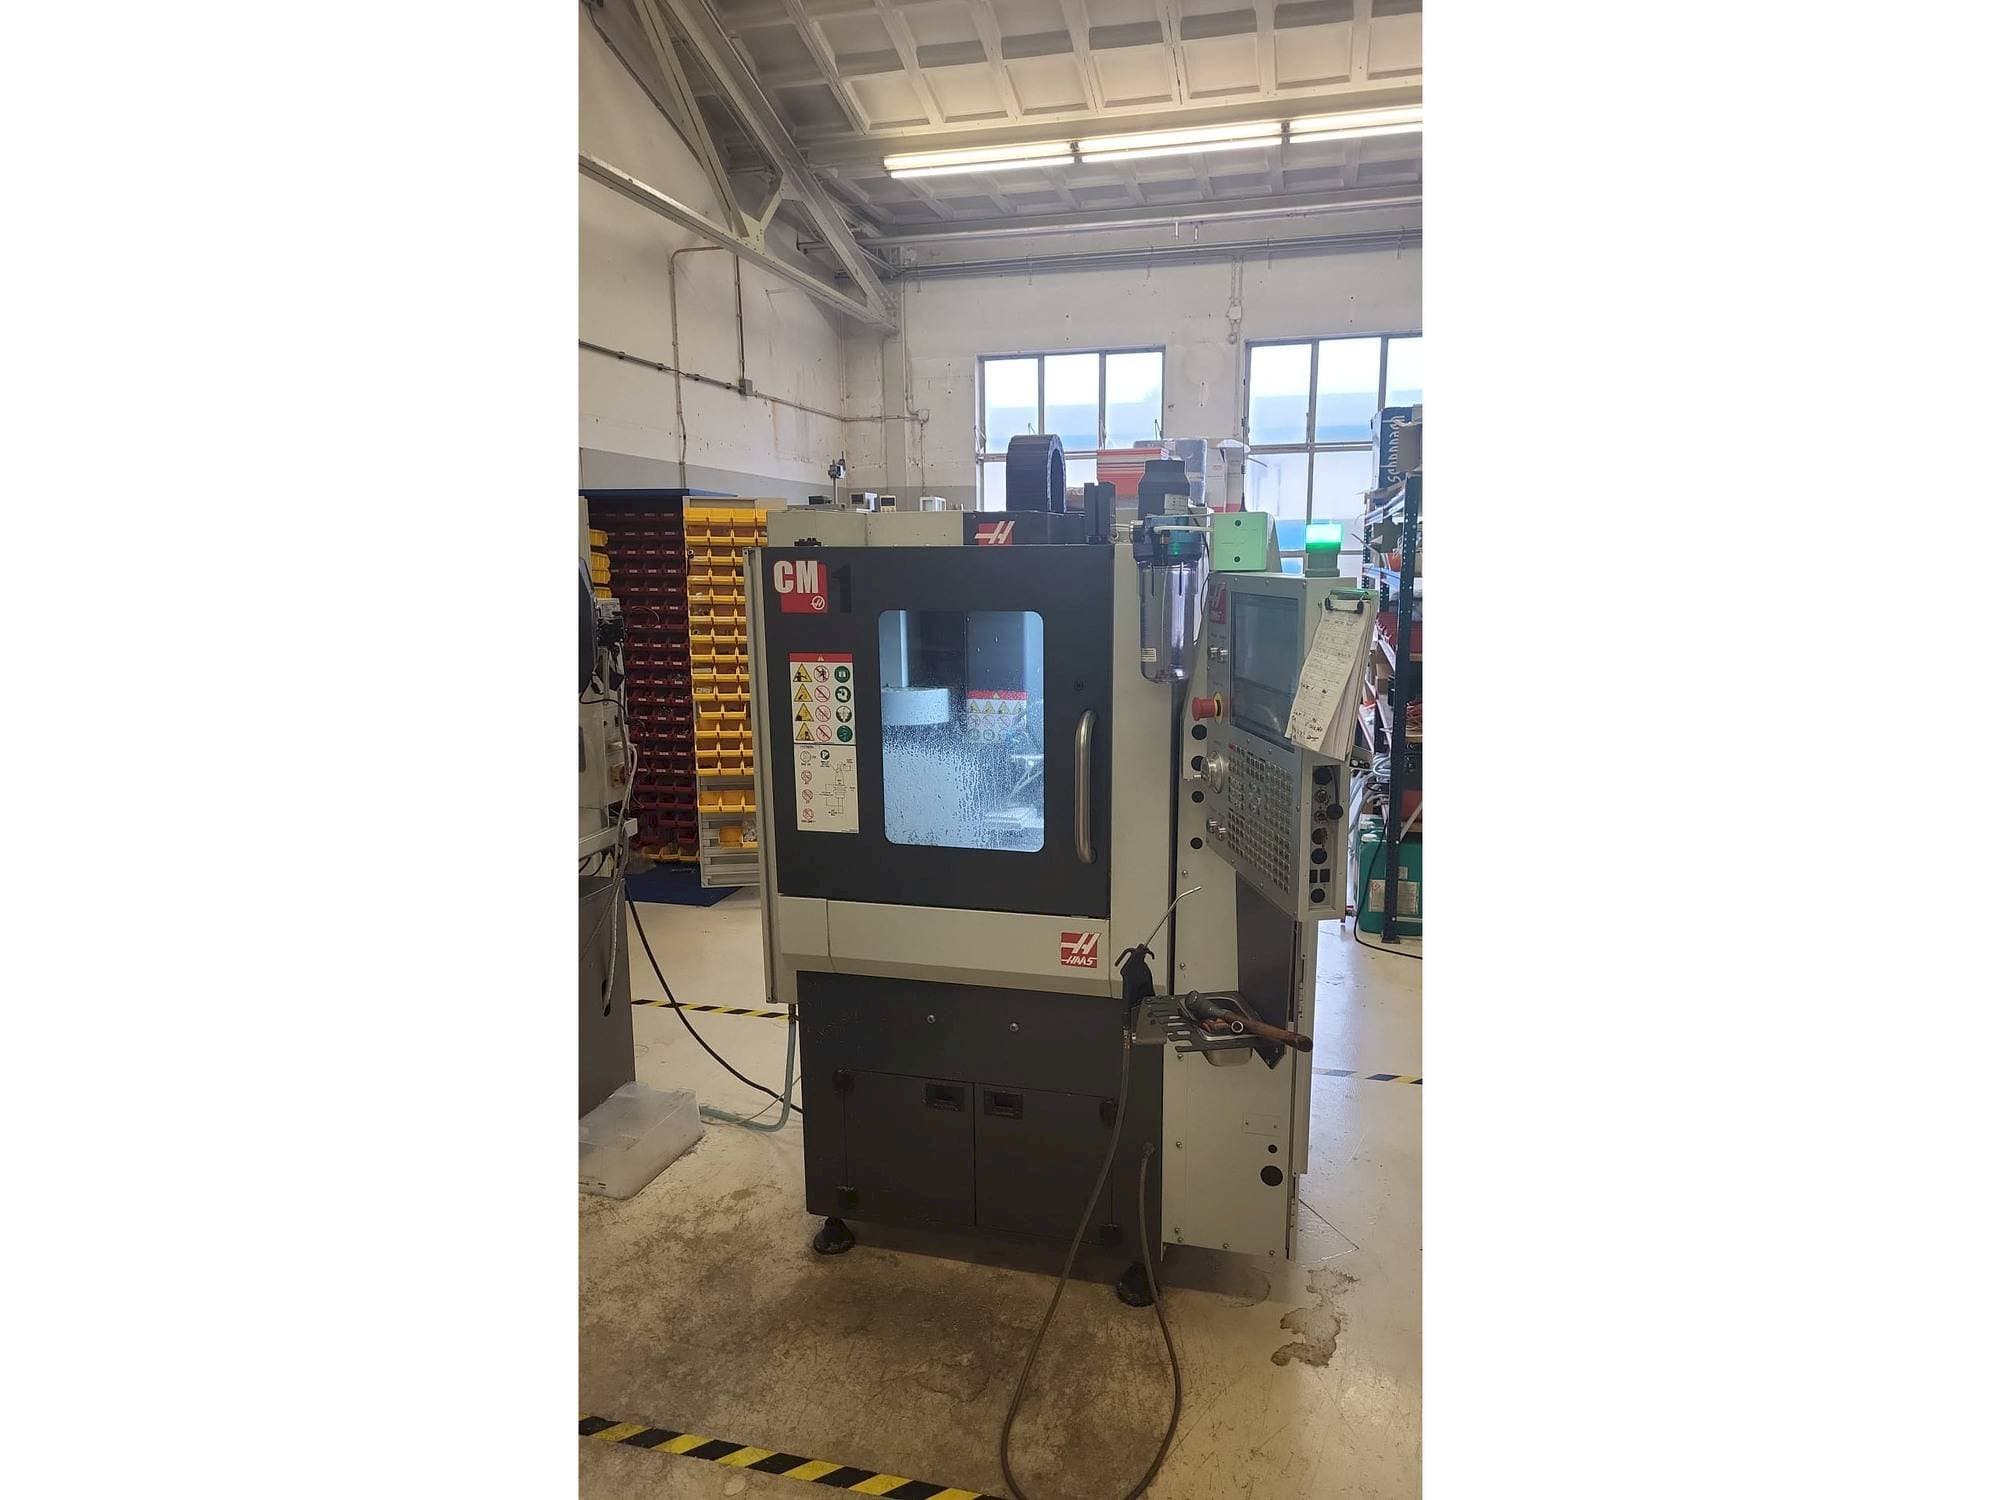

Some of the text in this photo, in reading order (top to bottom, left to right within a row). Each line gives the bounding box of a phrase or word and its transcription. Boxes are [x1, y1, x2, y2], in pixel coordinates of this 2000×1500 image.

[773, 560, 852, 613] CM 1
[1061, 955, 1097, 966] HAAS
